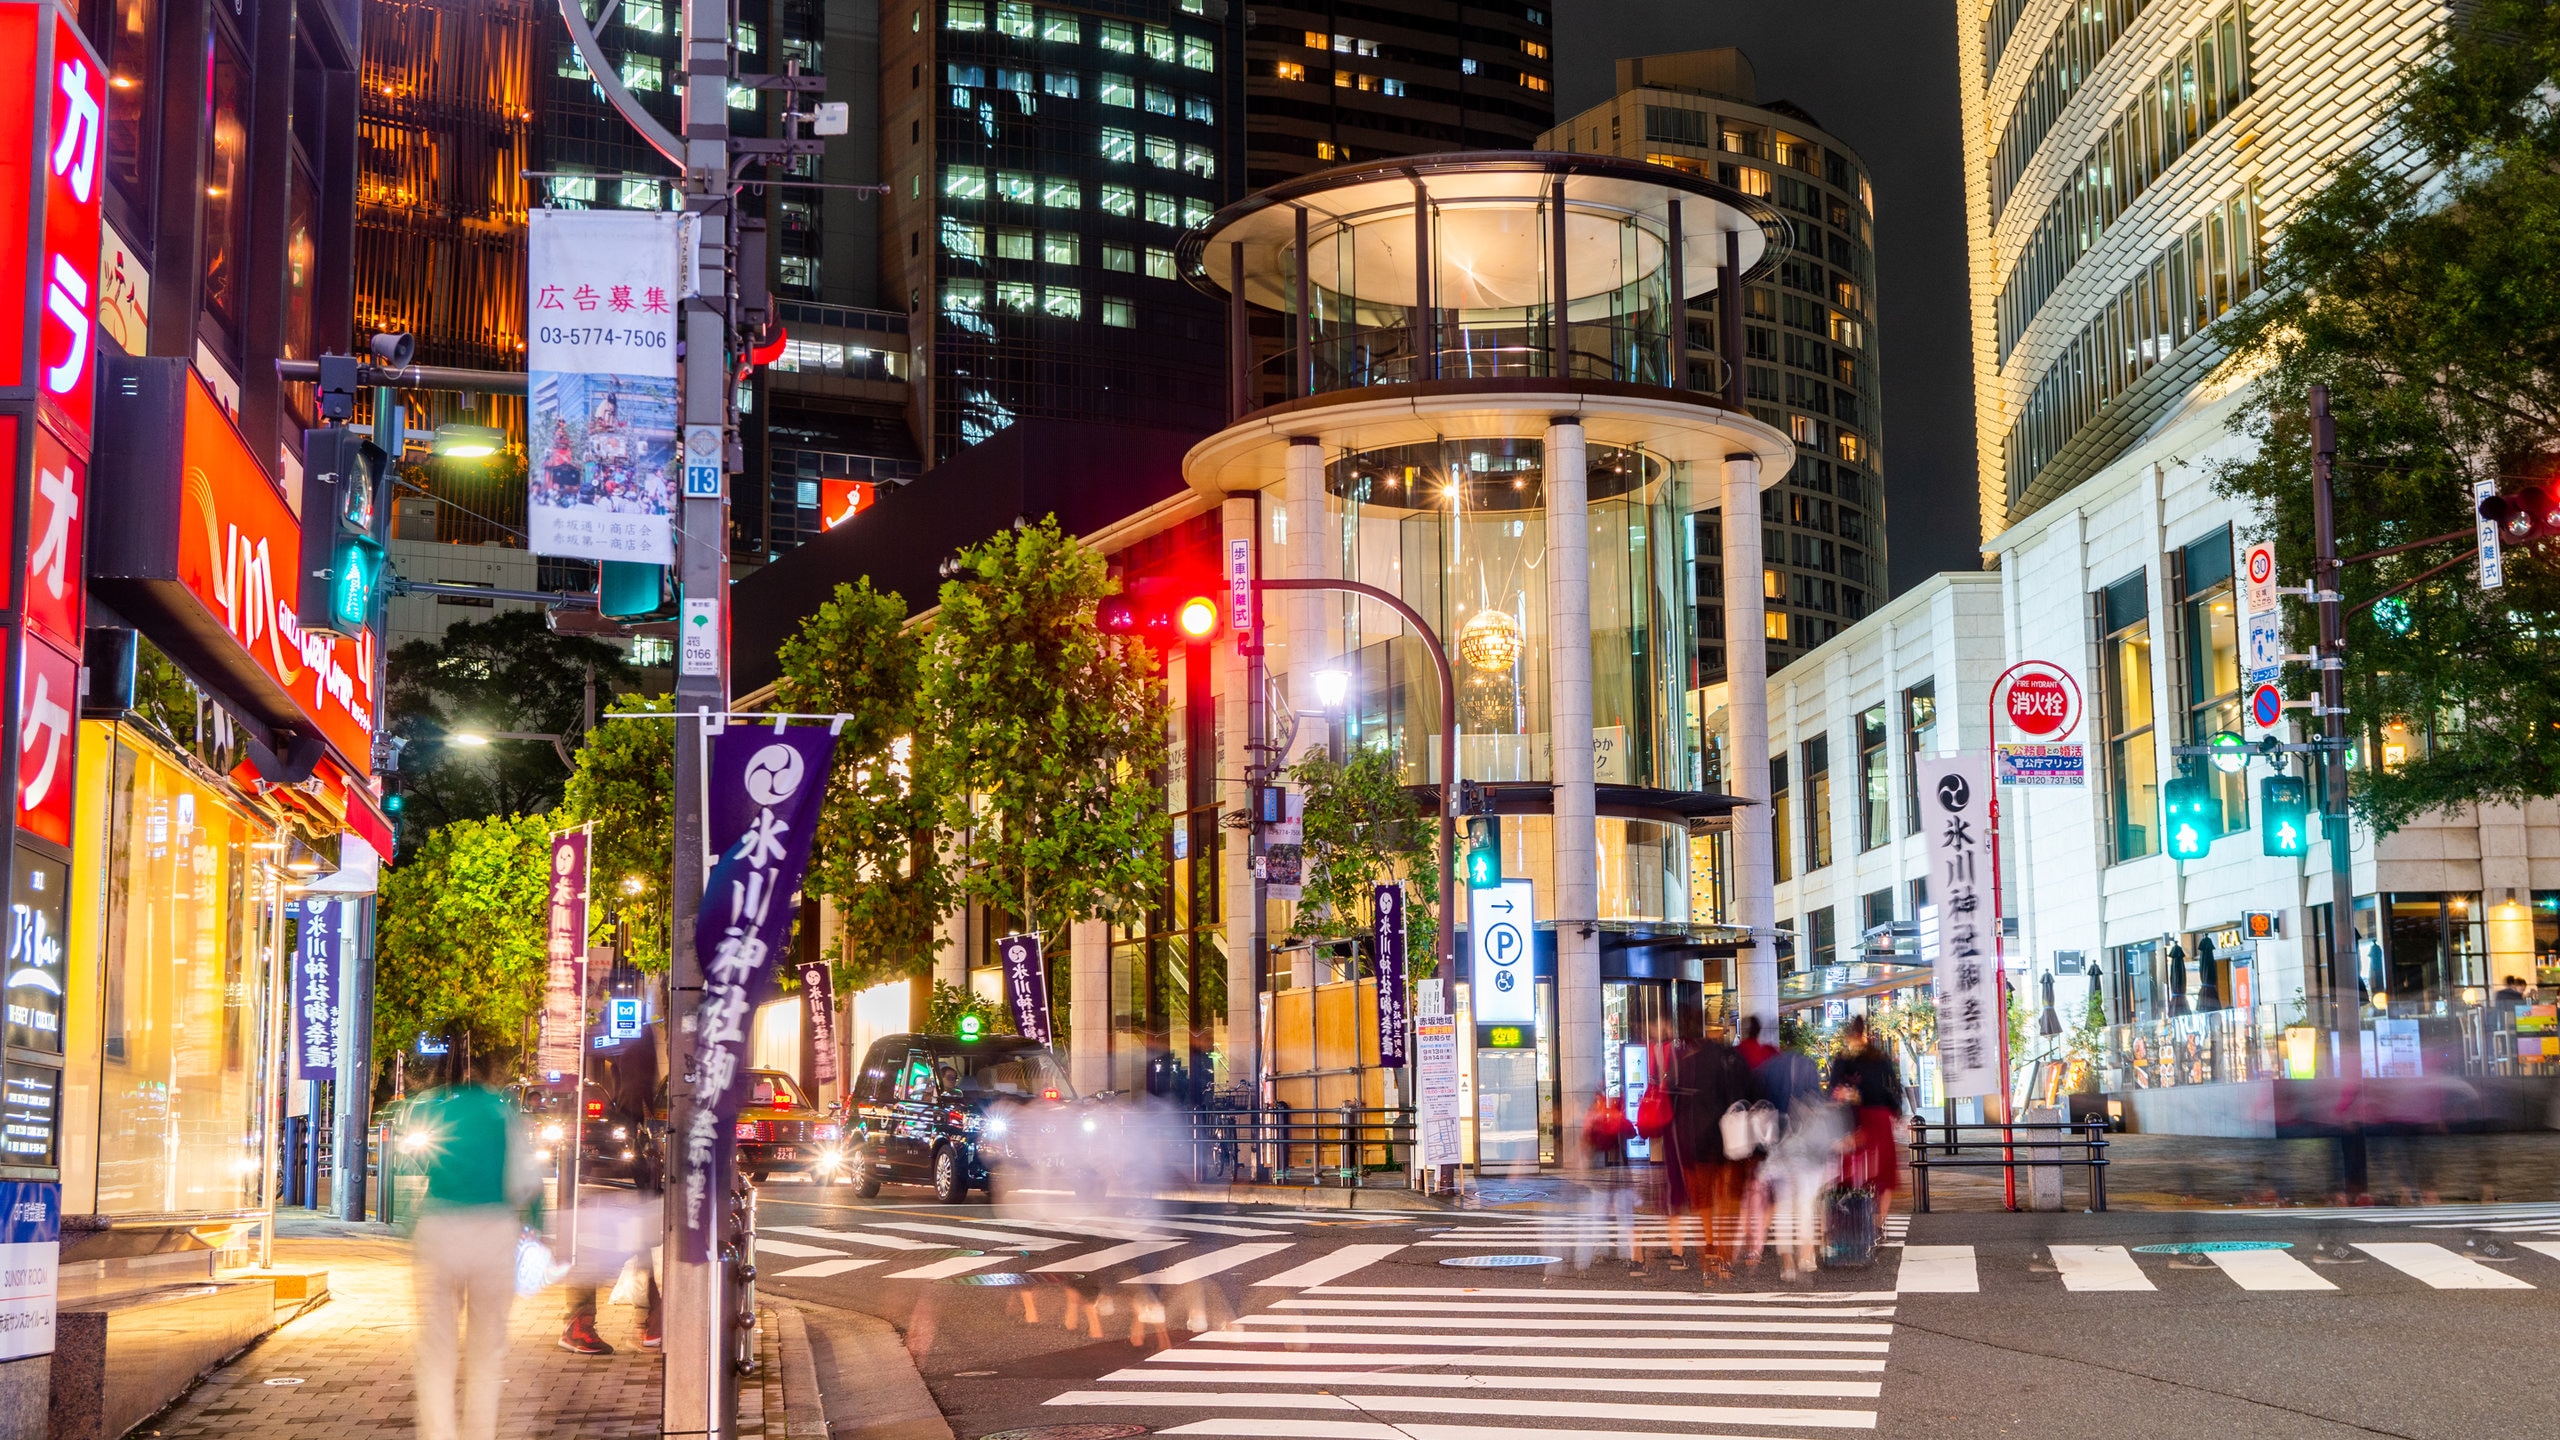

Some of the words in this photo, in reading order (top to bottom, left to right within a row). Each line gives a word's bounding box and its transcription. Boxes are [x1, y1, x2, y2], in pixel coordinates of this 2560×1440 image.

[536, 284, 671, 314] 広告募集
[540, 326, 667, 349] 03-5774-7506
[24, 59, 99, 811] カラオケ
[691, 467, 715, 492] 13
[2254, 557, 2267, 575] 30
[1234, 547, 1247, 622] 歩車分離式
[279, 599, 300, 651] GINZA
[686, 649, 711, 659] 0166
[2016, 680, 2030, 688] FIRE
[2031, 681, 2058, 689] HYDRANT
[2012, 691, 2064, 717] 消火栓
[2013, 745, 2083, 757] 公務員との婚活
[2014, 758, 2083, 769] 官公庁マリッジ
[1419, 1016, 1453, 1026] 赤坂地域
[4, 1268, 28, 1288] SUNSKY
